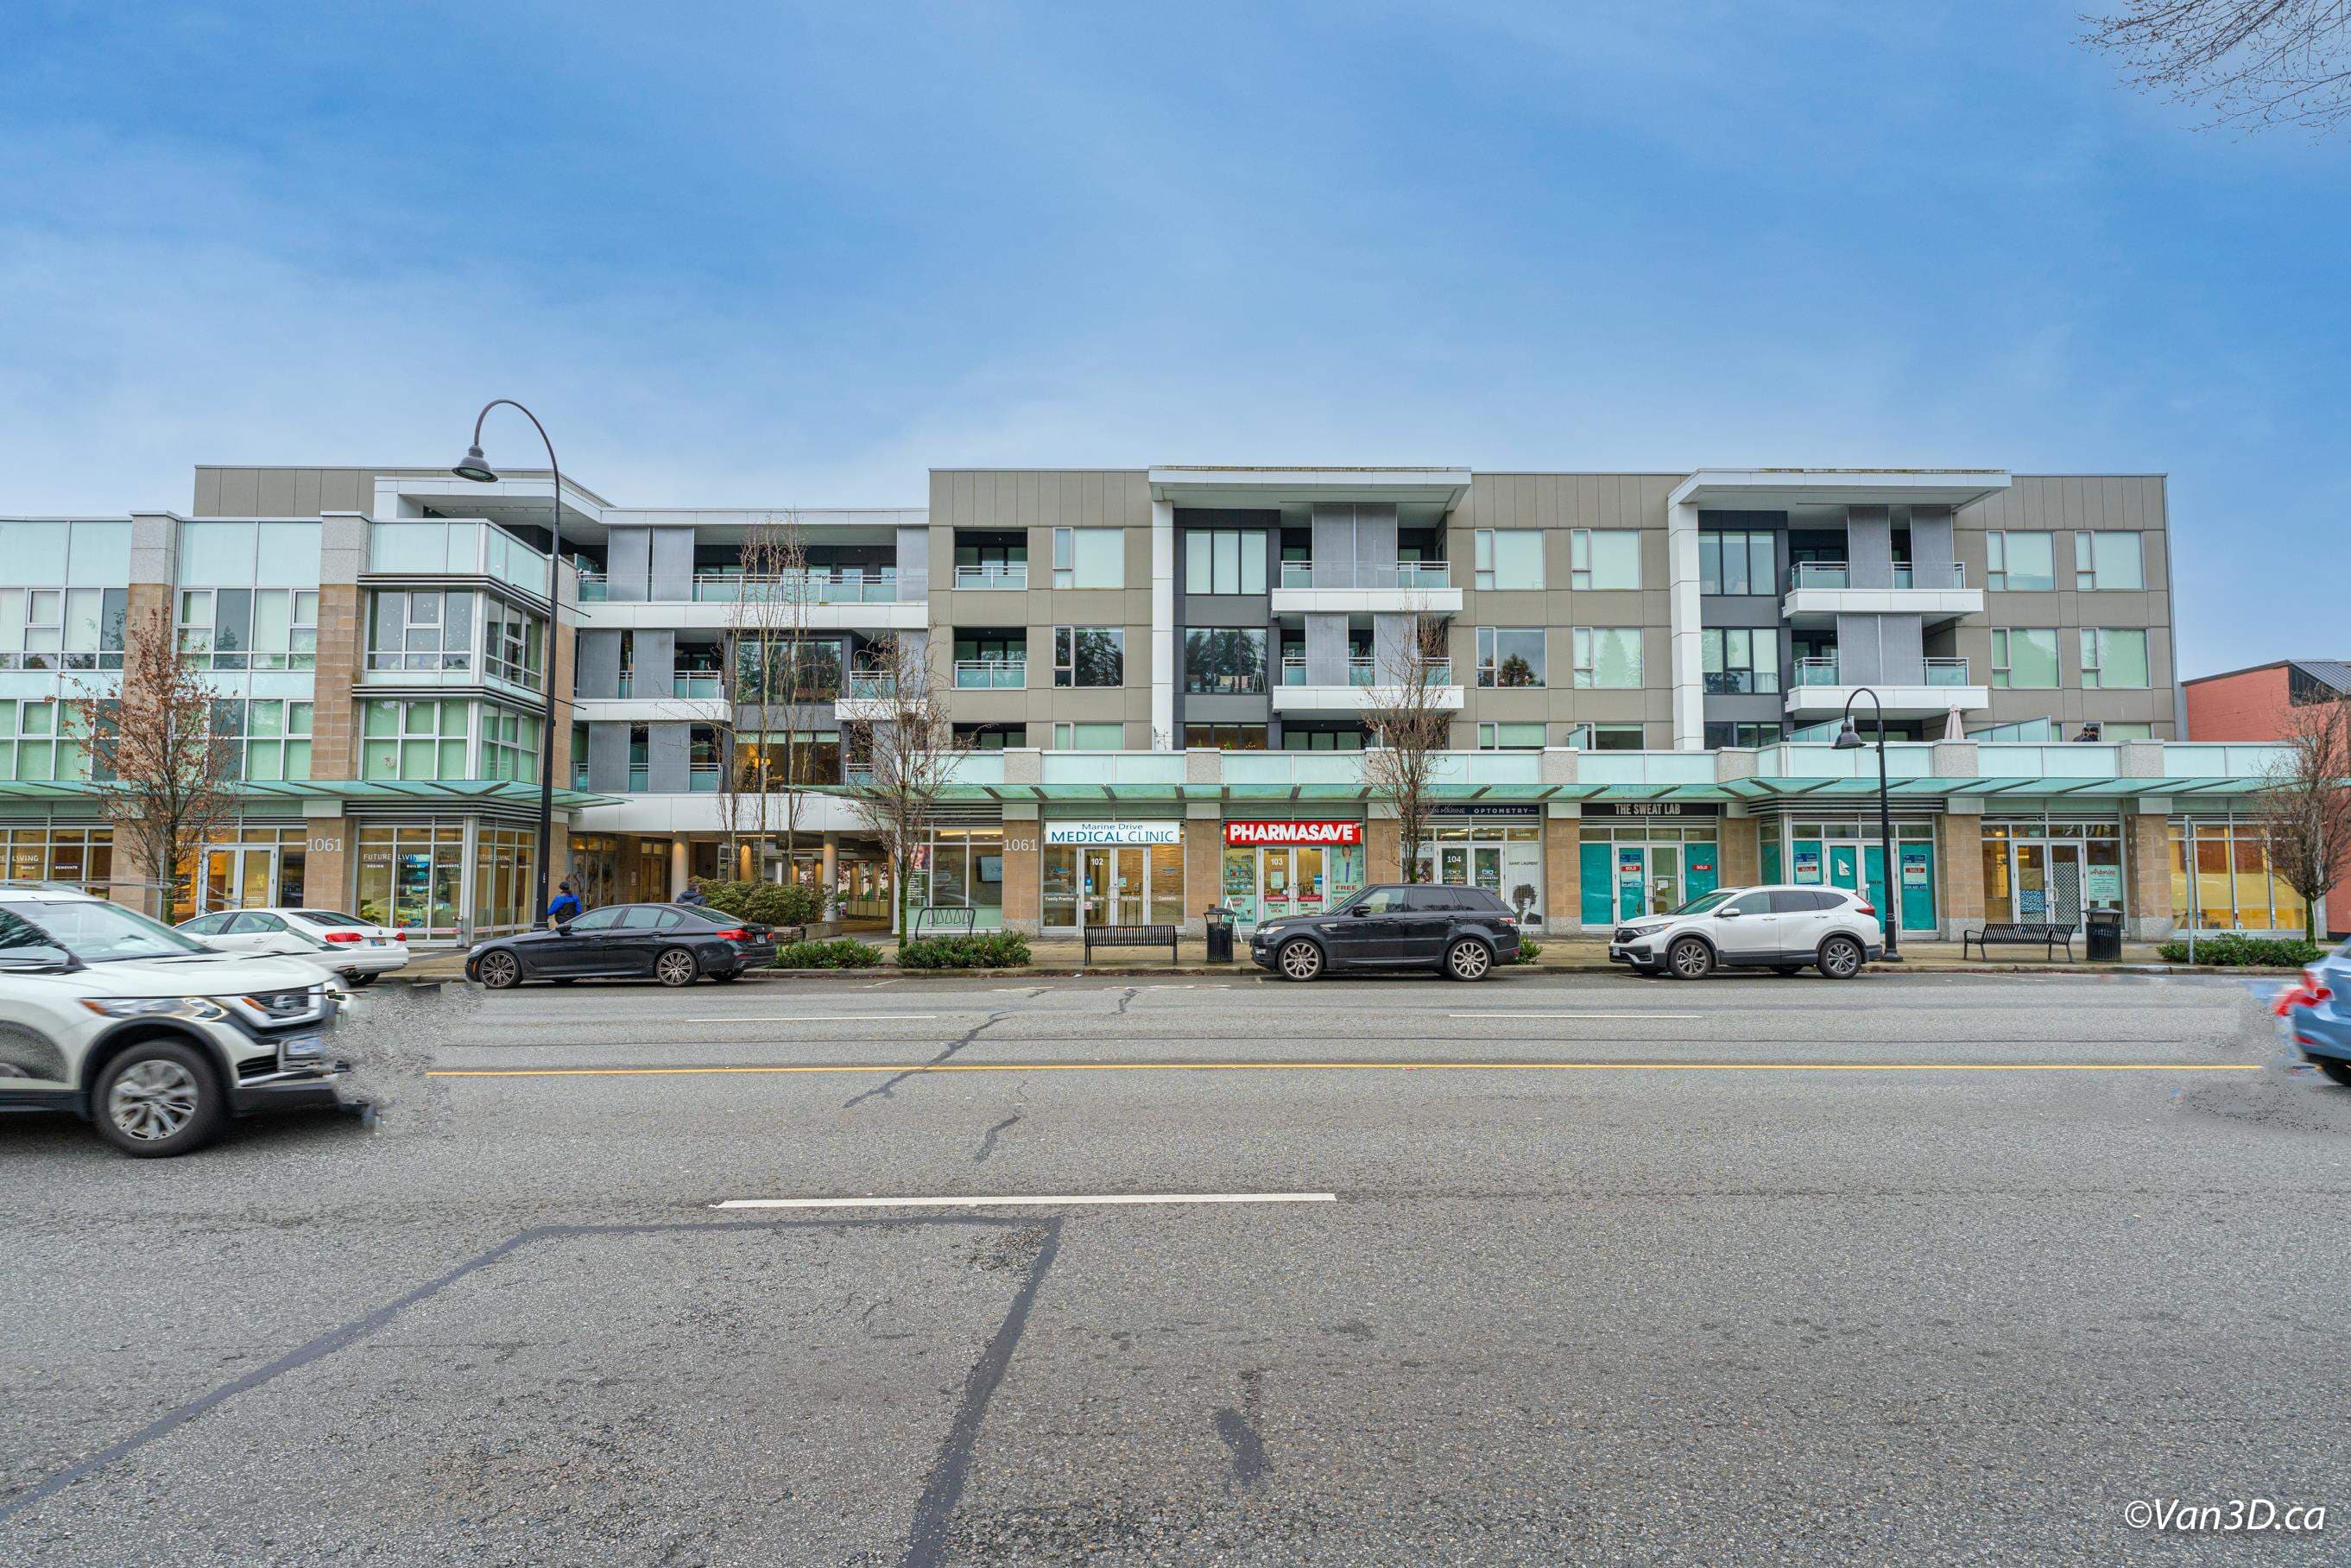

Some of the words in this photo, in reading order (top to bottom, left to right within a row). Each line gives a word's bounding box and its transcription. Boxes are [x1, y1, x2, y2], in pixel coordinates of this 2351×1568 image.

[1615, 803, 1632, 815] THE
[1633, 803, 1663, 815] SWEAT
[1664, 803, 1681, 815] LAB
[1051, 831, 1124, 843] MEDICAL
[1128, 831, 1174, 843] CLINIC
[1229, 824, 1353, 841] PHARMASAVE
[307, 838, 343, 851] 1061
[1003, 838, 1038, 851] 1061
[1090, 857, 1104, 866] 102
[1270, 857, 1284, 866] 103
